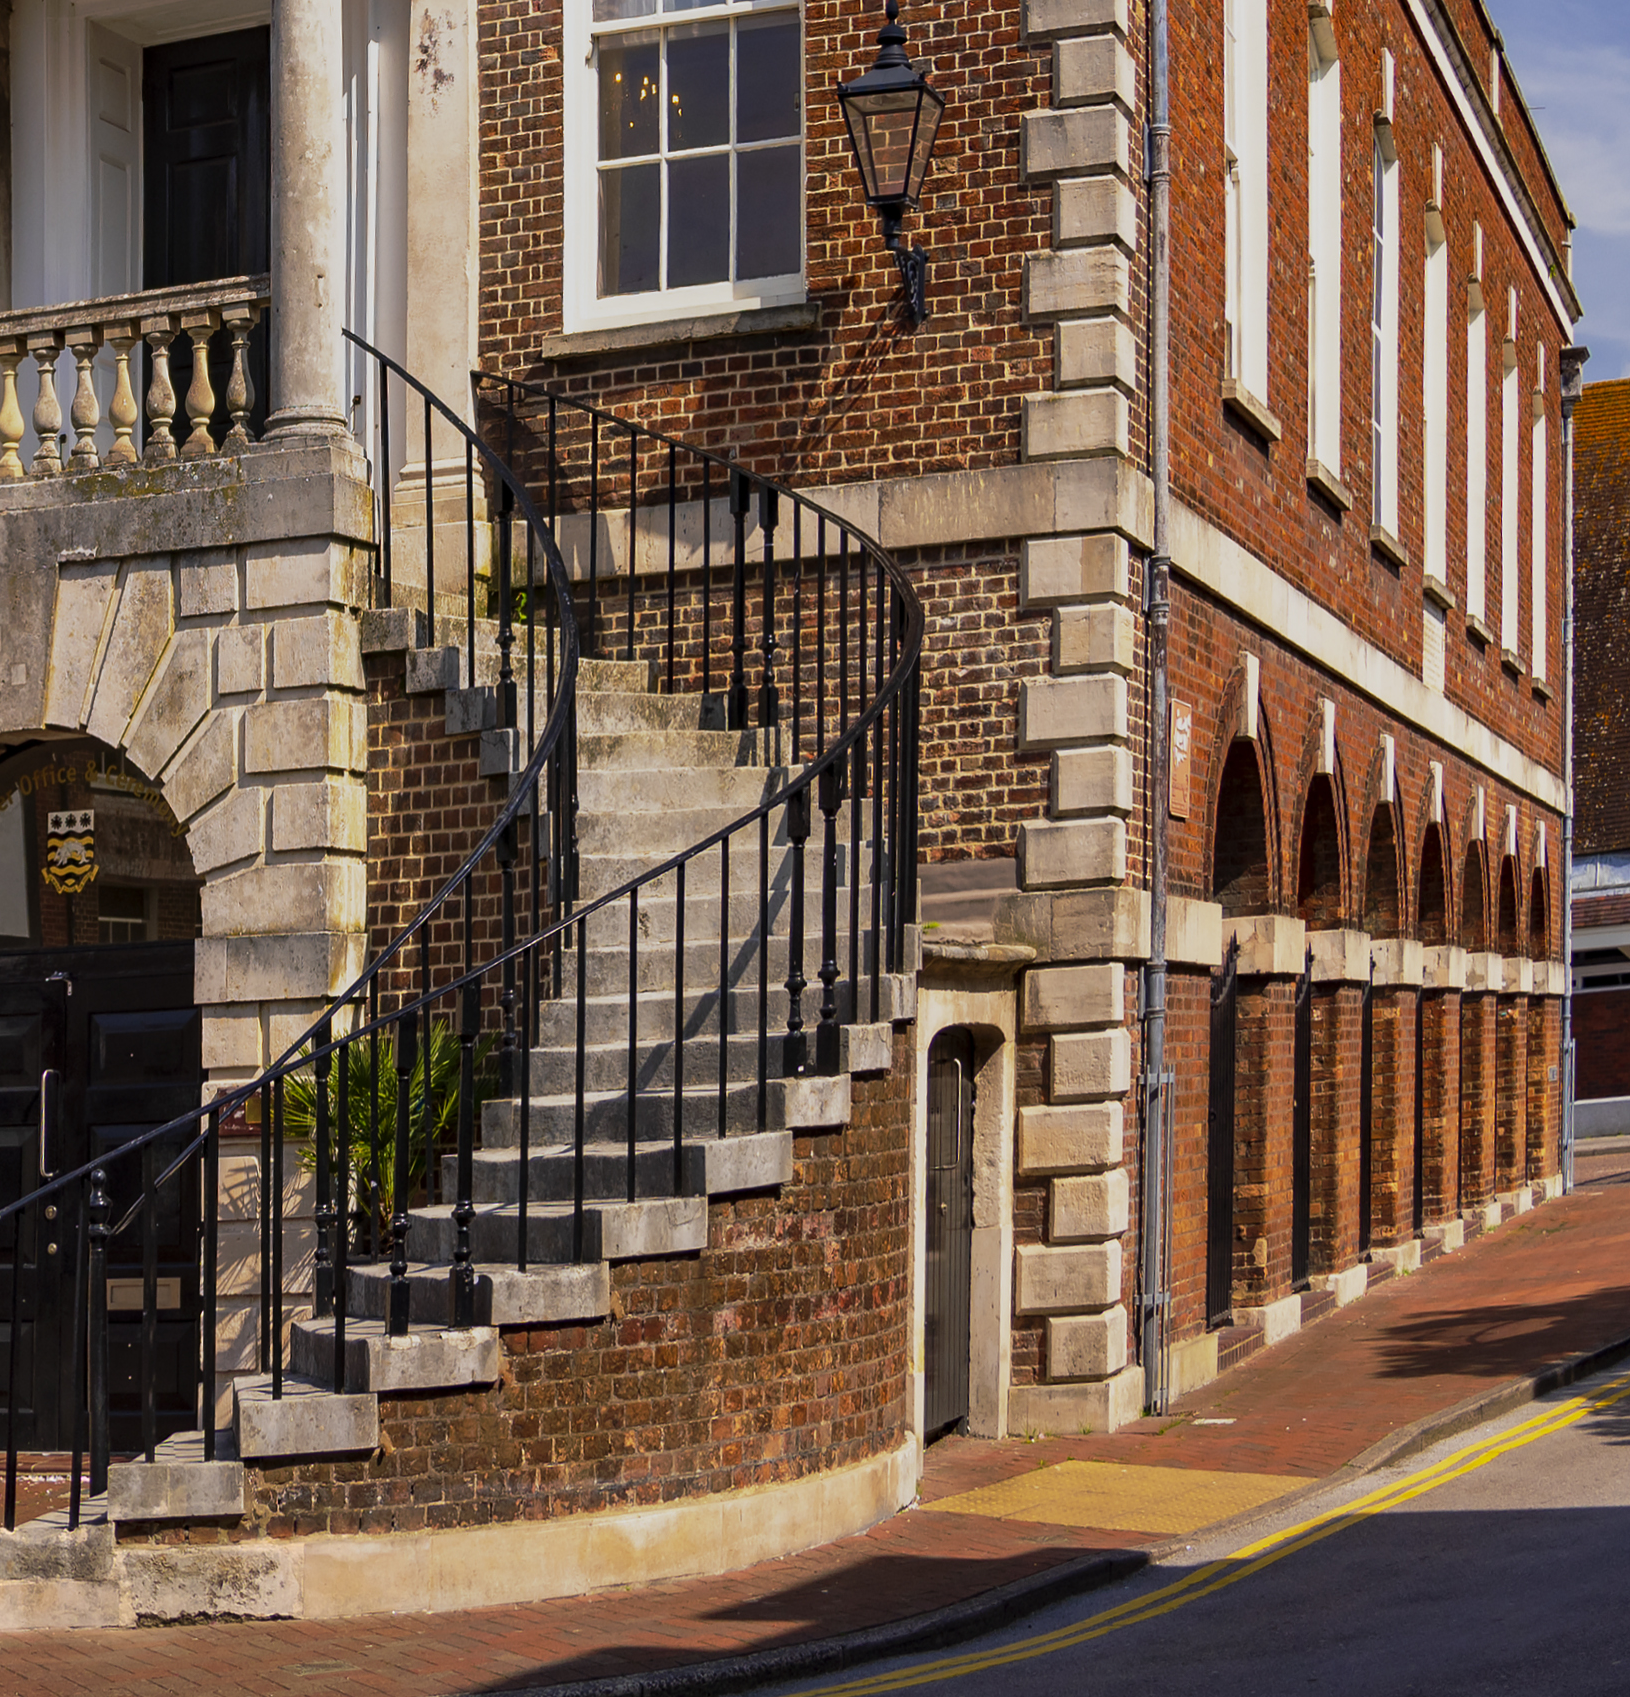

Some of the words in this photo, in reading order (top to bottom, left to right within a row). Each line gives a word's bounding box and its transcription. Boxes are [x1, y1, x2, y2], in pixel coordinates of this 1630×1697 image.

[18, 763, 77, 797] Office
[83, 759, 99, 783] &
[105, 764, 191, 838] Ceremony
